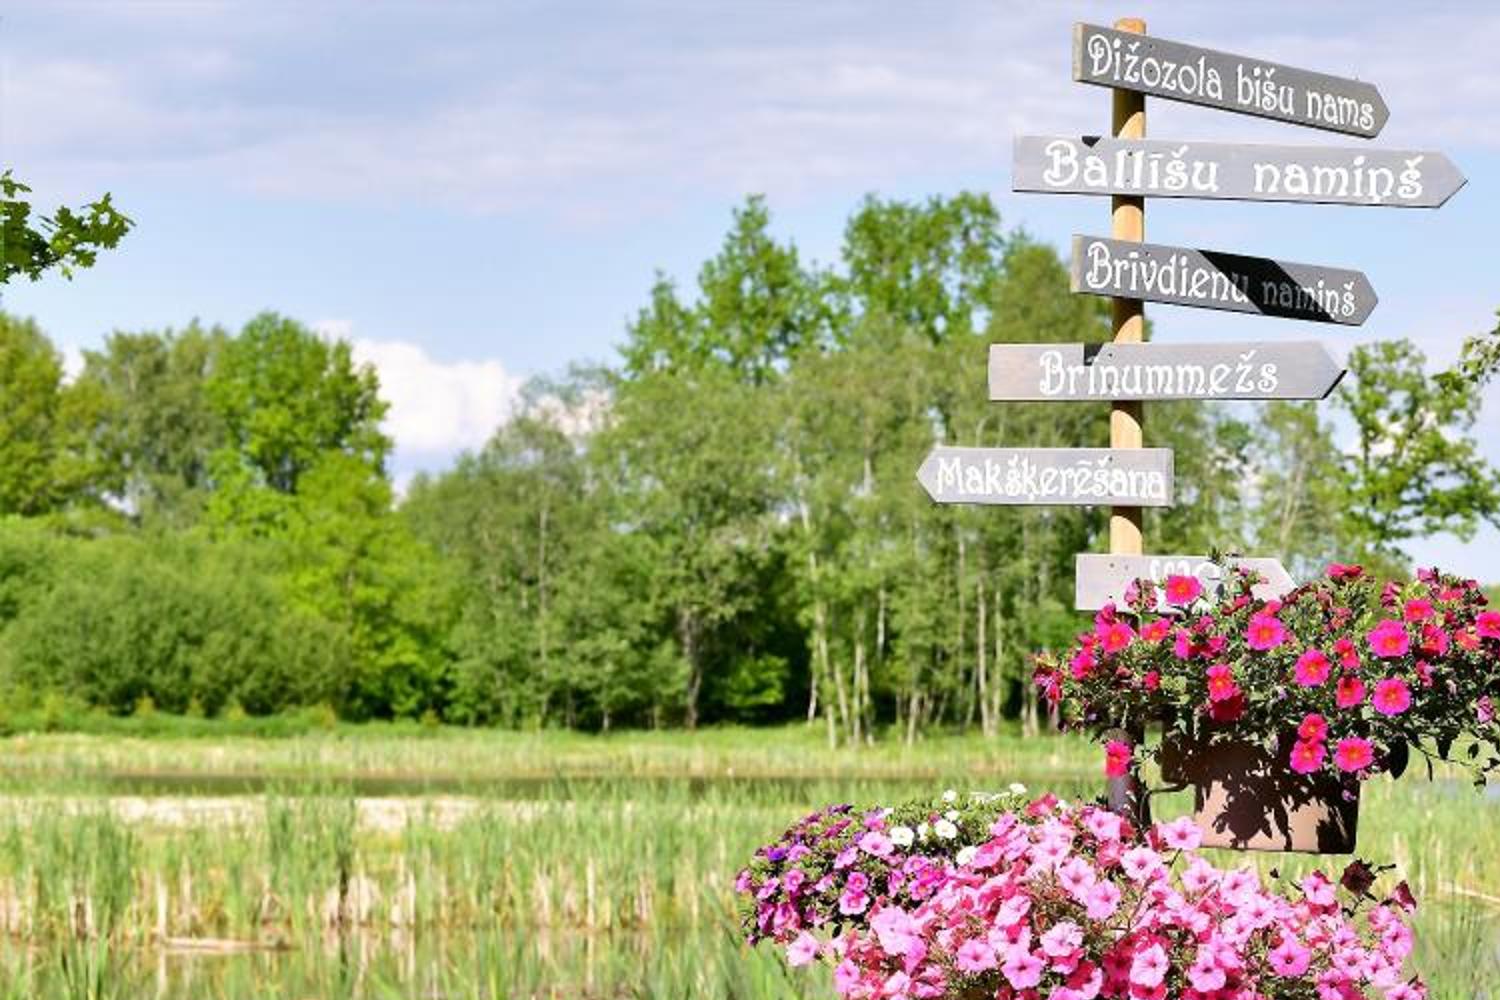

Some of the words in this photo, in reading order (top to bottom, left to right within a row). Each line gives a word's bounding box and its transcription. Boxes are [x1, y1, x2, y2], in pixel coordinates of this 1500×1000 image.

[1087, 33, 1223, 101] Dižozola
[1237, 64, 1295, 115] bišu
[1305, 90, 1375, 131] nams
[1253, 154, 1424, 202] namiņš
[1262, 278, 1355, 319] namiņš
[936, 454, 1168, 500] Makšķerēšana
